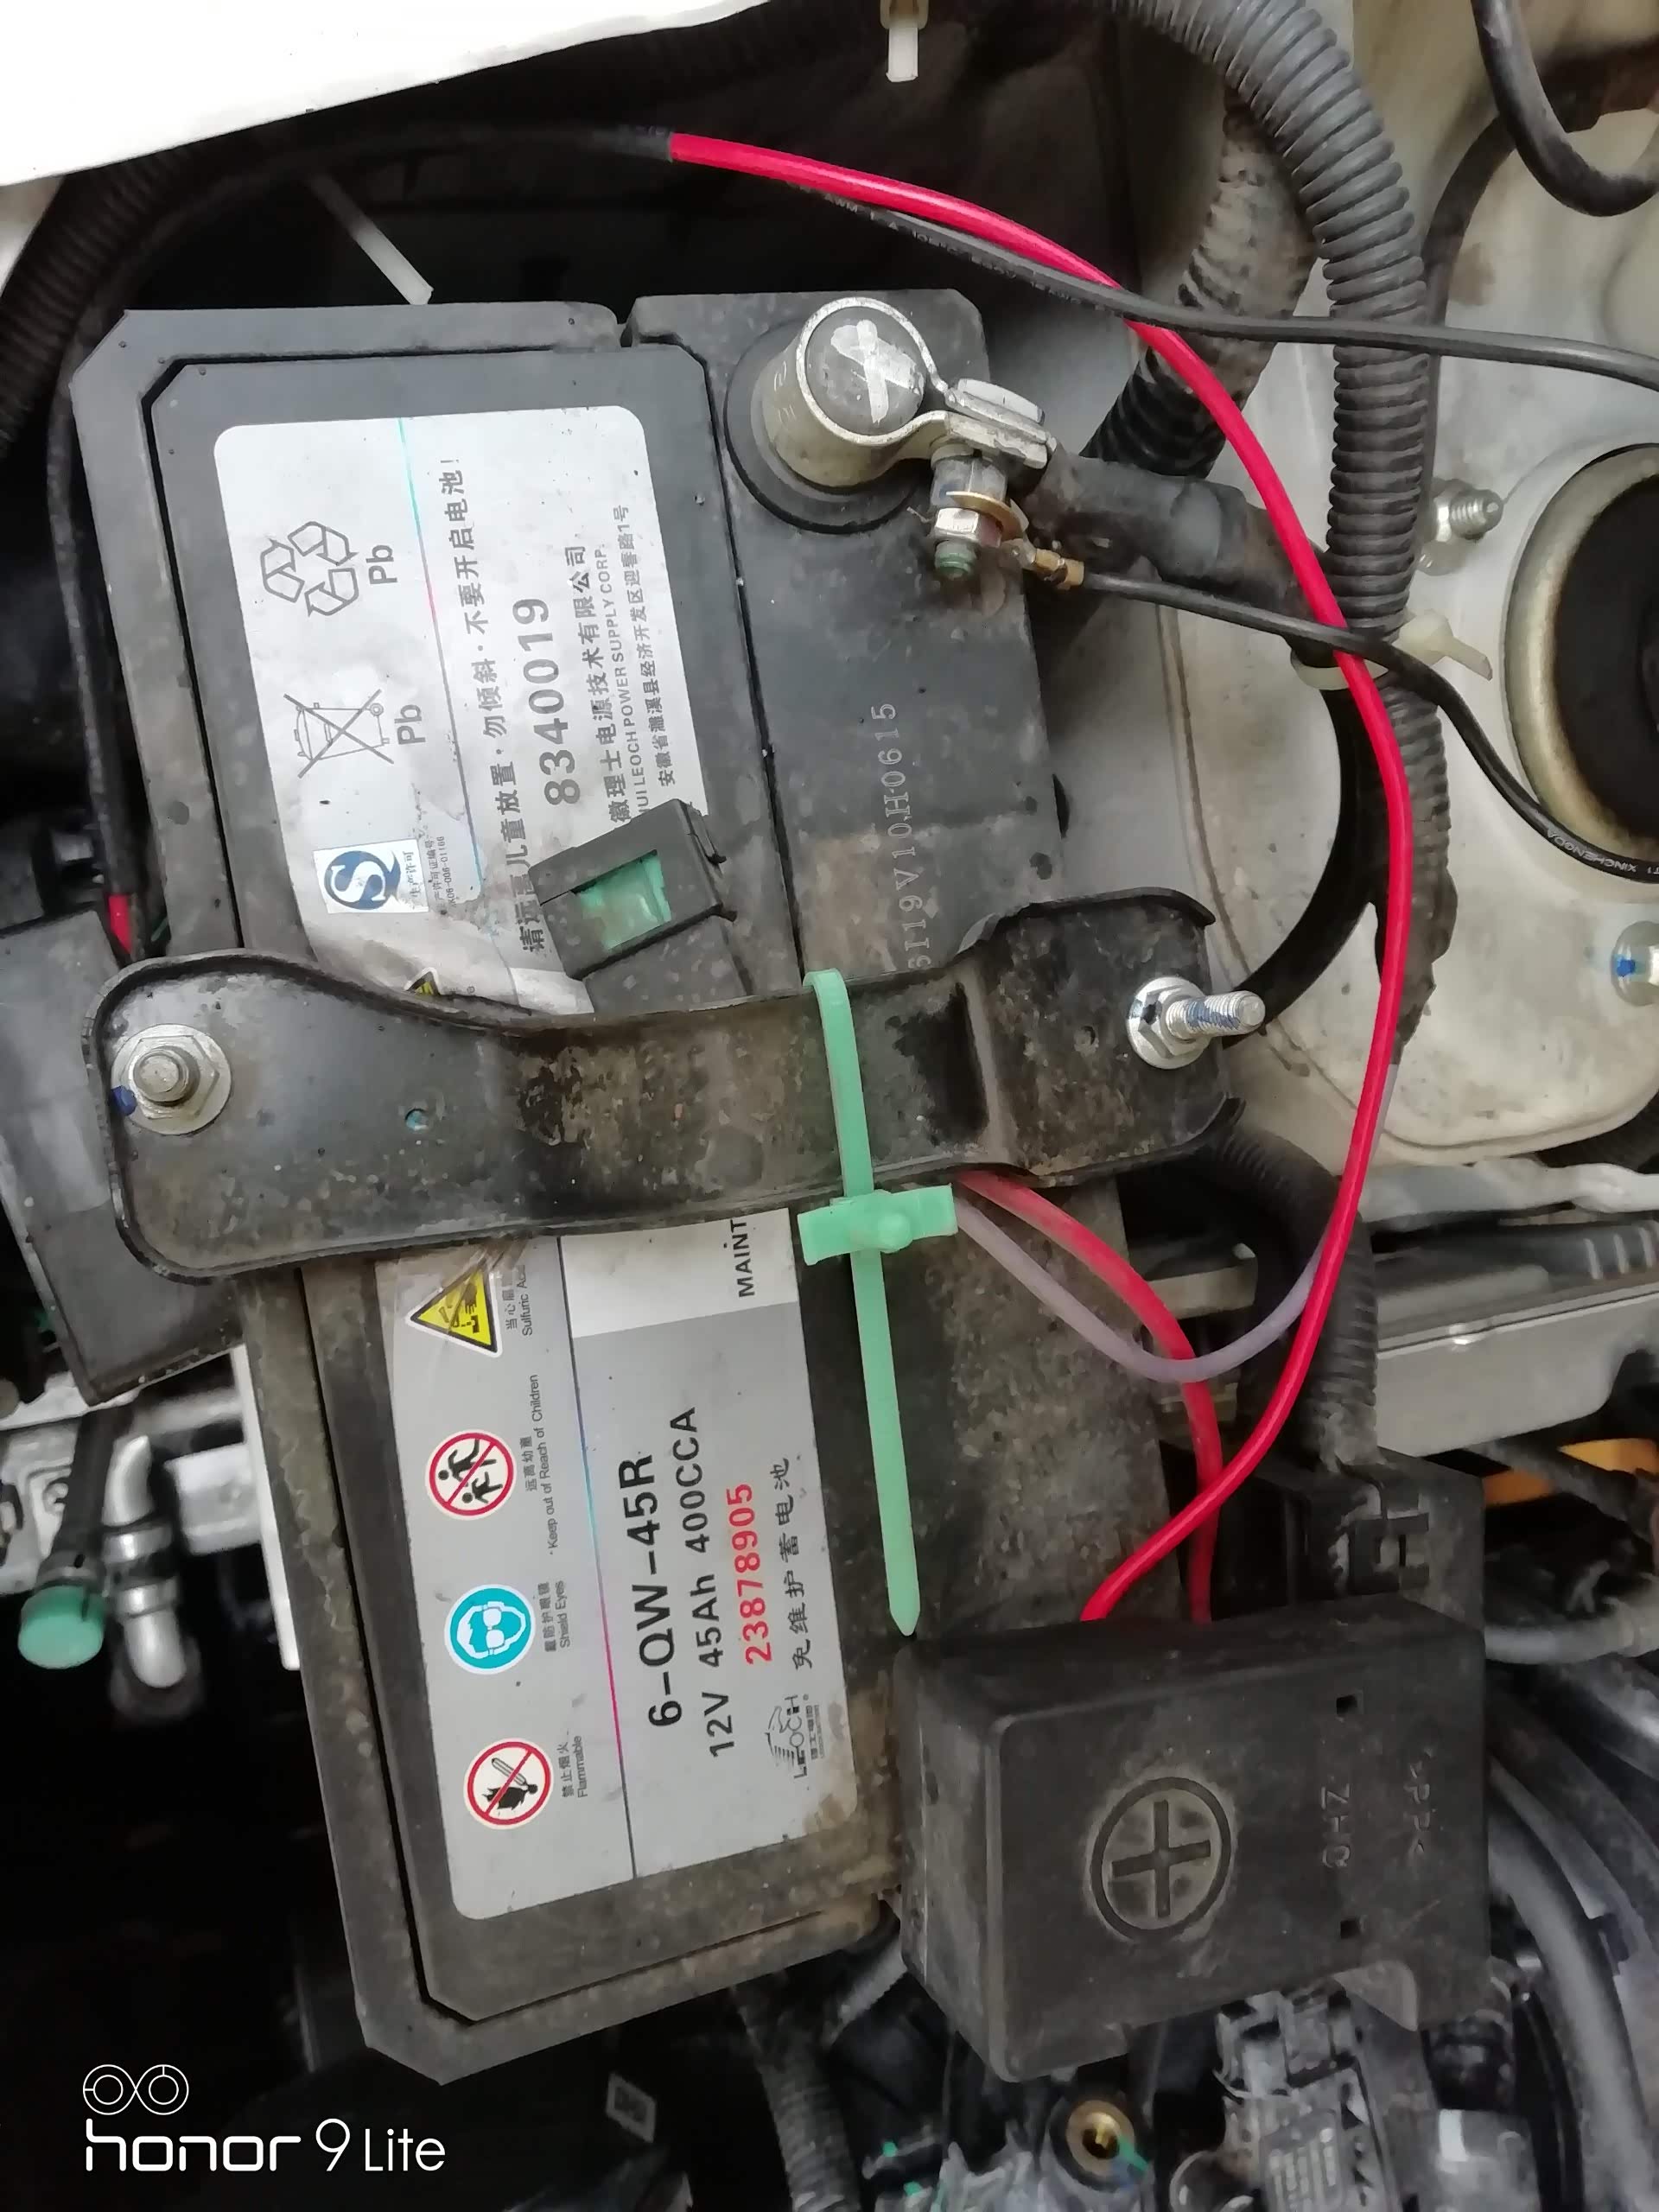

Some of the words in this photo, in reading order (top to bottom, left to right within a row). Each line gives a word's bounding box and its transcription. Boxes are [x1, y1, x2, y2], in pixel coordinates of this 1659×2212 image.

[365, 544, 397, 584] Pb
[594, 543, 613, 594] CORP.
[603, 599, 625, 663] SUPPLY
[512, 599, 581, 805] 8340019
[614, 666, 636, 727] POWER
[394, 704, 426, 745] Pb
[625, 731, 646, 785] LEOCH
[730, 1218, 756, 1298] MAINT
[518, 1294, 533, 1336] Sulfuric
[529, 1374, 543, 1422] Children
[533, 1427, 545, 1438] of
[537, 1442, 551, 1478] Reach
[670, 1407, 709, 1554] 400CCA
[541, 1483, 553, 1494] of
[543, 1497, 555, 1515] out
[546, 1518, 559, 1549] Keep
[618, 1454, 683, 1726] 6-QW-45R
[726, 1484, 772, 1665] 23878905
[770, 1458, 812, 1669] 免维护蓄电池
[555, 1580, 568, 1611] Eyes
[690, 1574, 723, 1668] 45Ah
[556, 1612, 570, 1649] Shield
[702, 1692, 734, 1758] 12V
[556, 1740, 575, 1798] 禁止烟火
[572, 1735, 588, 1798] Flammable
